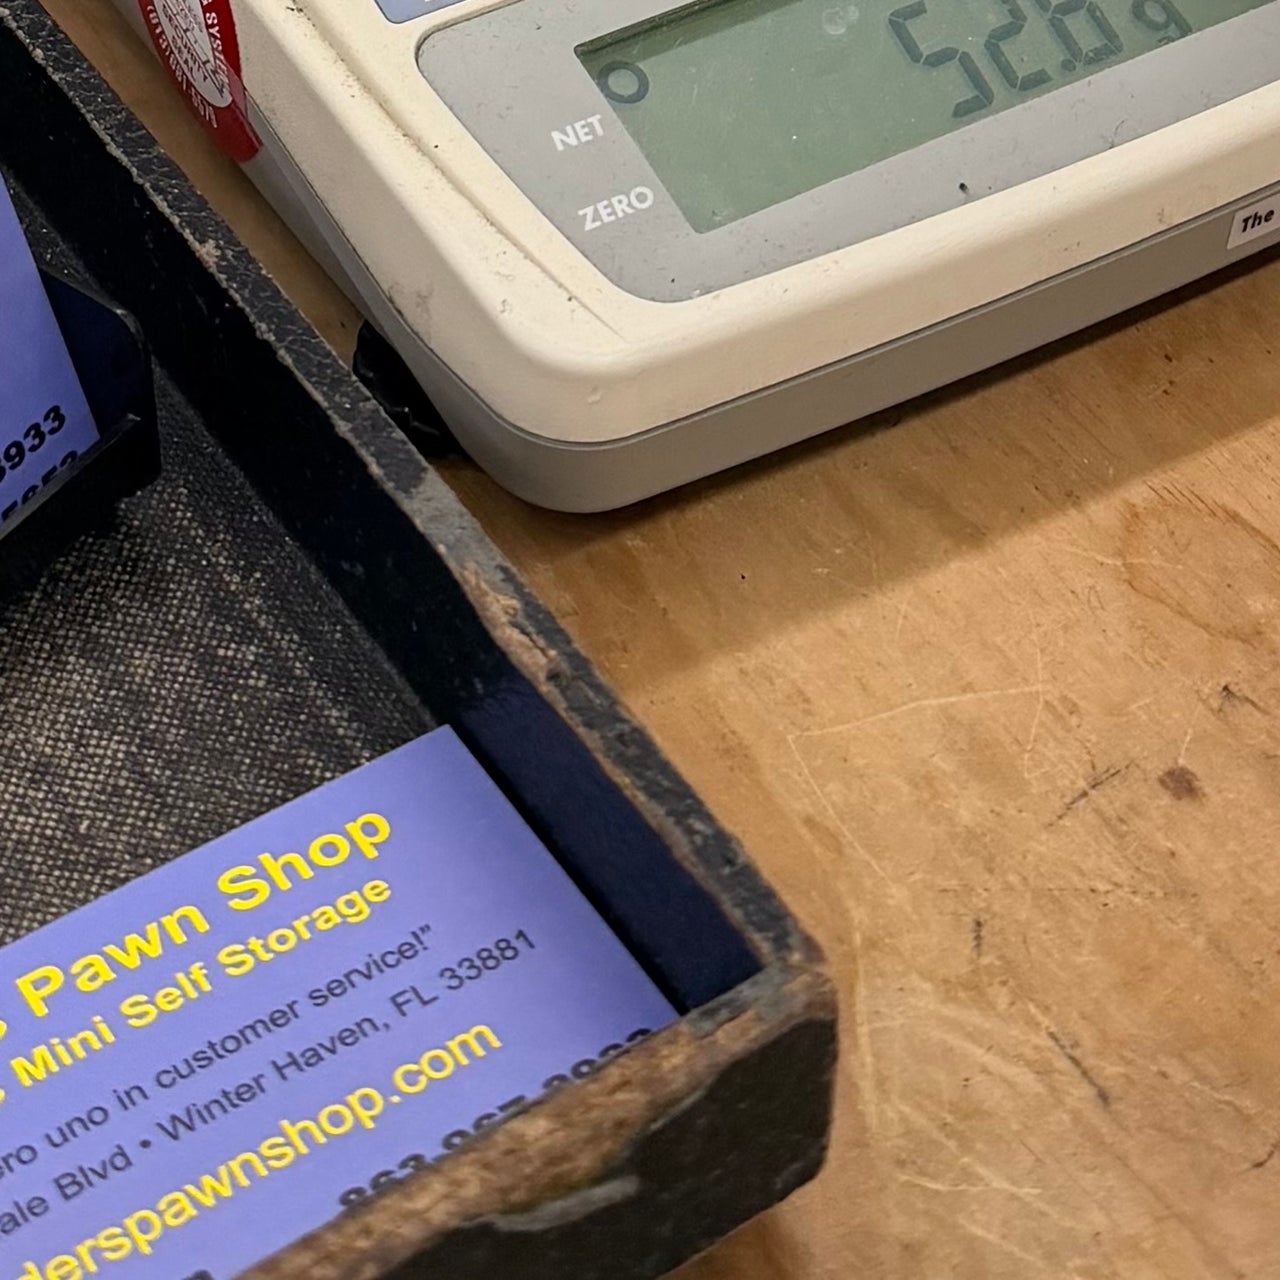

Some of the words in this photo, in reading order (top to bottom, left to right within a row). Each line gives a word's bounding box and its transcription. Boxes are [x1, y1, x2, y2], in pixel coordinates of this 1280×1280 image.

[550, 112, 606, 152] NET
[577, 184, 656, 233] ZERO
[1238, 206, 1275, 234] The
[9, 1014, 116, 1088] Mini
[119, 962, 216, 1029] Self
[217, 877, 393, 977] Storage
[15, 903, 211, 1017] Pawn
[217, 811, 392, 912] Shop
[44, 1105, 110, 1148] uno
[112, 1084, 150, 1112] in
[154, 996, 300, 1092] customer
[53, 1144, 134, 1202] Blvd
[156, 1073, 268, 1143] Winter
[272, 1012, 392, 1081] Haven,
[391, 983, 441, 1019] FL
[440, 927, 537, 990] 33881
